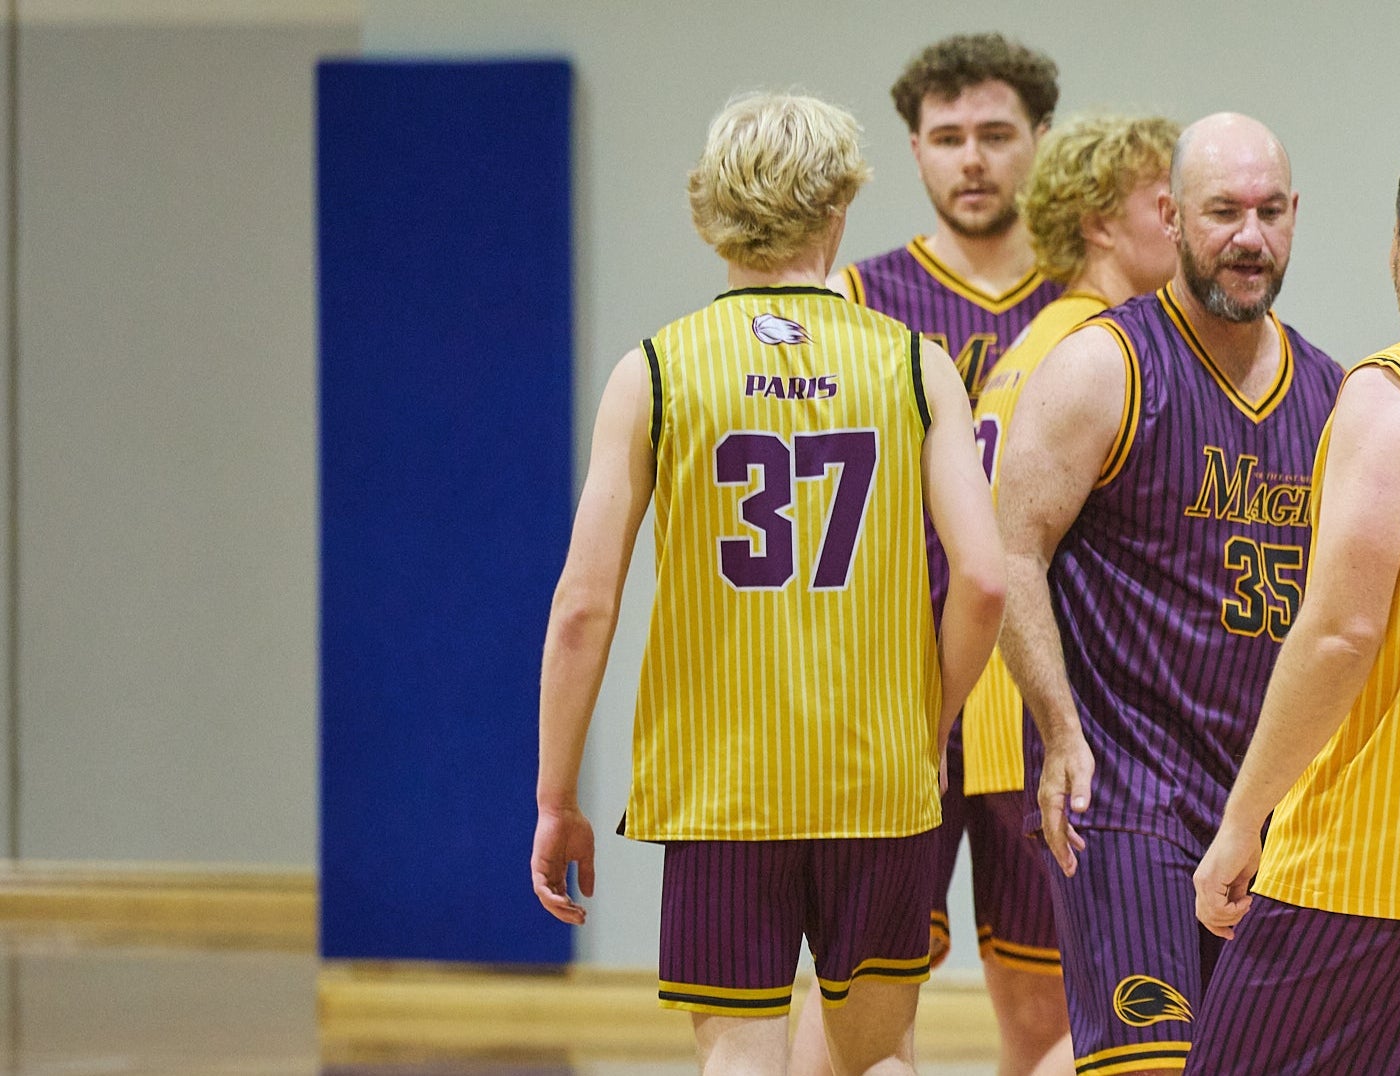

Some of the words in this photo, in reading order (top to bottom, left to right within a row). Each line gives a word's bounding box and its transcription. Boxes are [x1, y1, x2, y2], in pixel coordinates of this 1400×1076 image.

[744, 374, 838, 400] PARIS
[713, 427, 880, 592] 37
[1184, 445, 1313, 527] MAGI
[1221, 535, 1304, 643] 35
